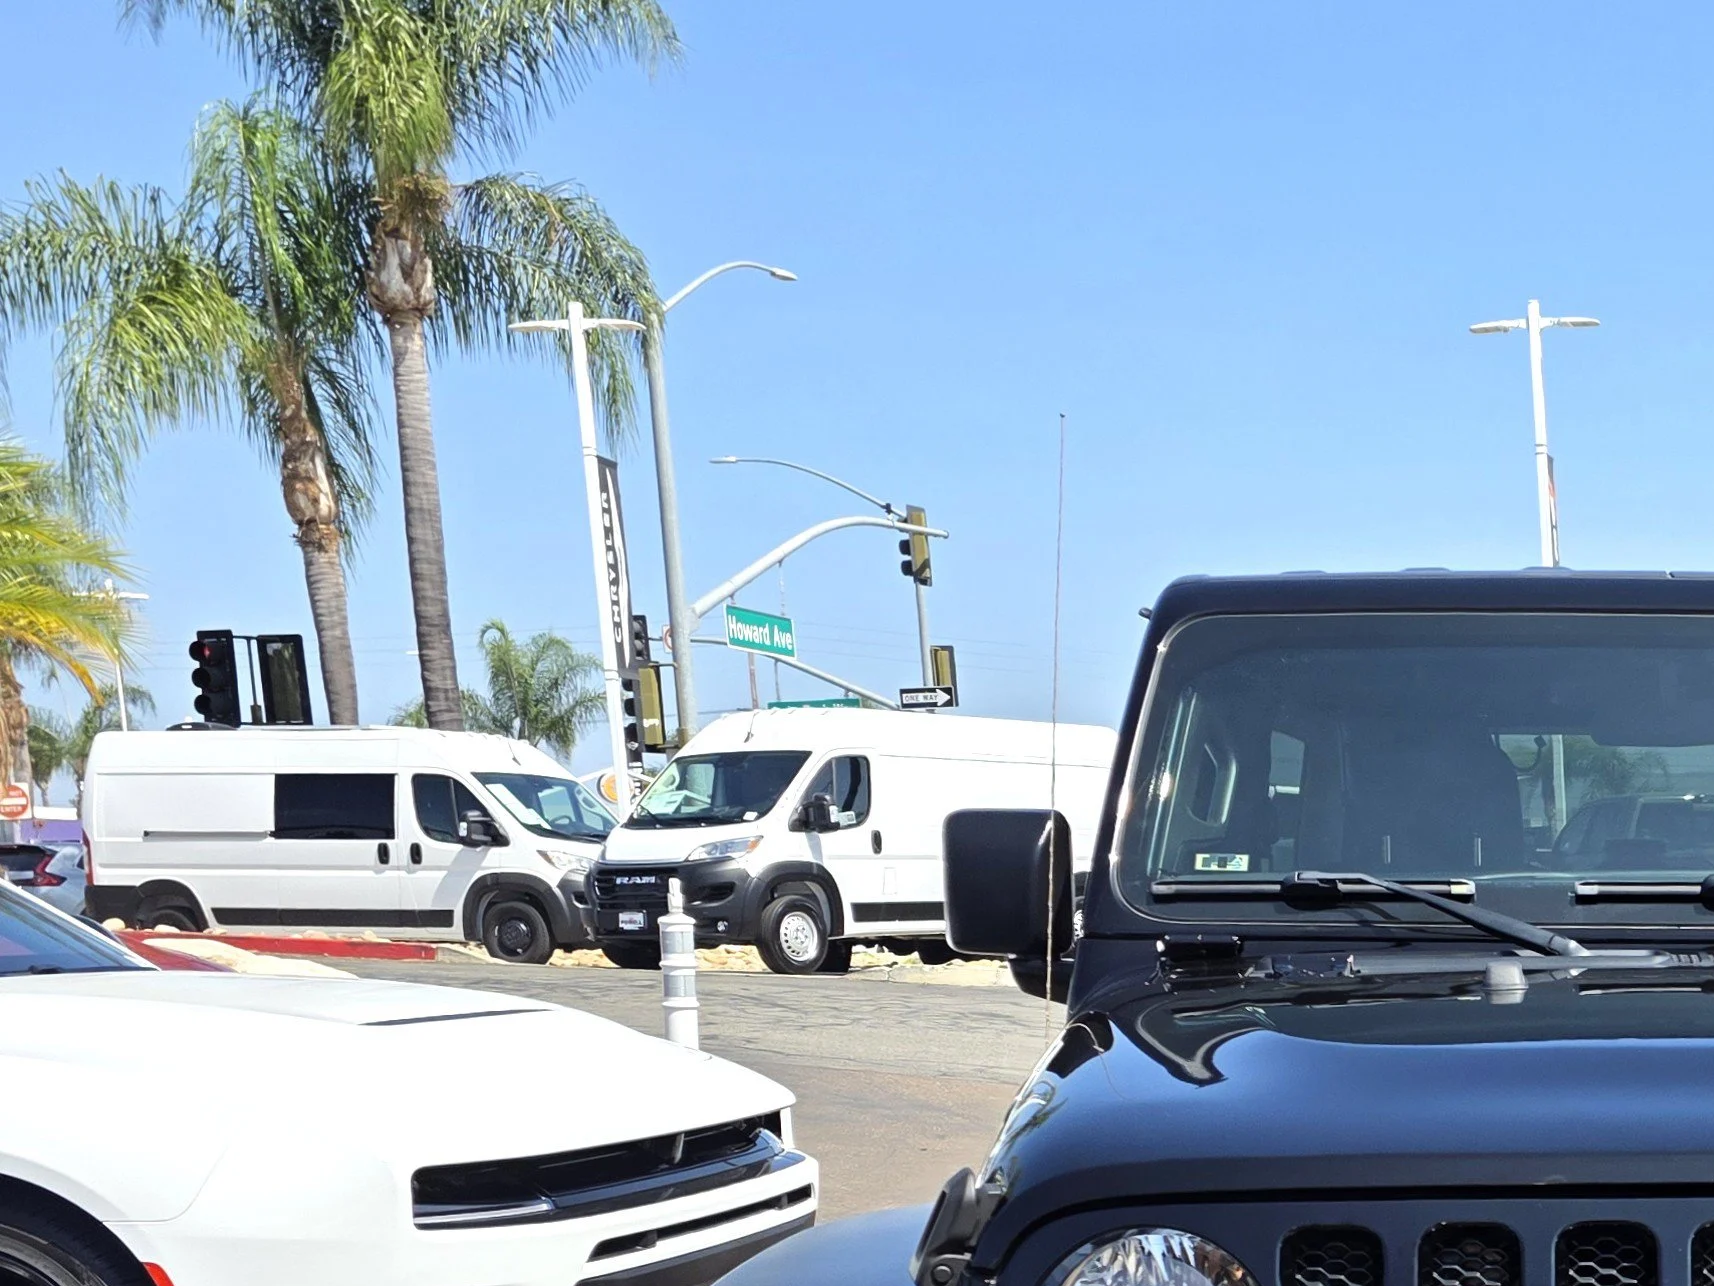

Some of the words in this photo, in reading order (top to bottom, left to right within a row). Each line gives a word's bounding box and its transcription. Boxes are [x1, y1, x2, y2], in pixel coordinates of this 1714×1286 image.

[601, 492, 622, 643] CHRYSLER
[728, 614, 771, 646] Howard
[773, 624, 793, 650] Ave
[904, 694, 920, 702] ONE
[922, 693, 938, 701] WAY
[616, 876, 656, 885] RAM
